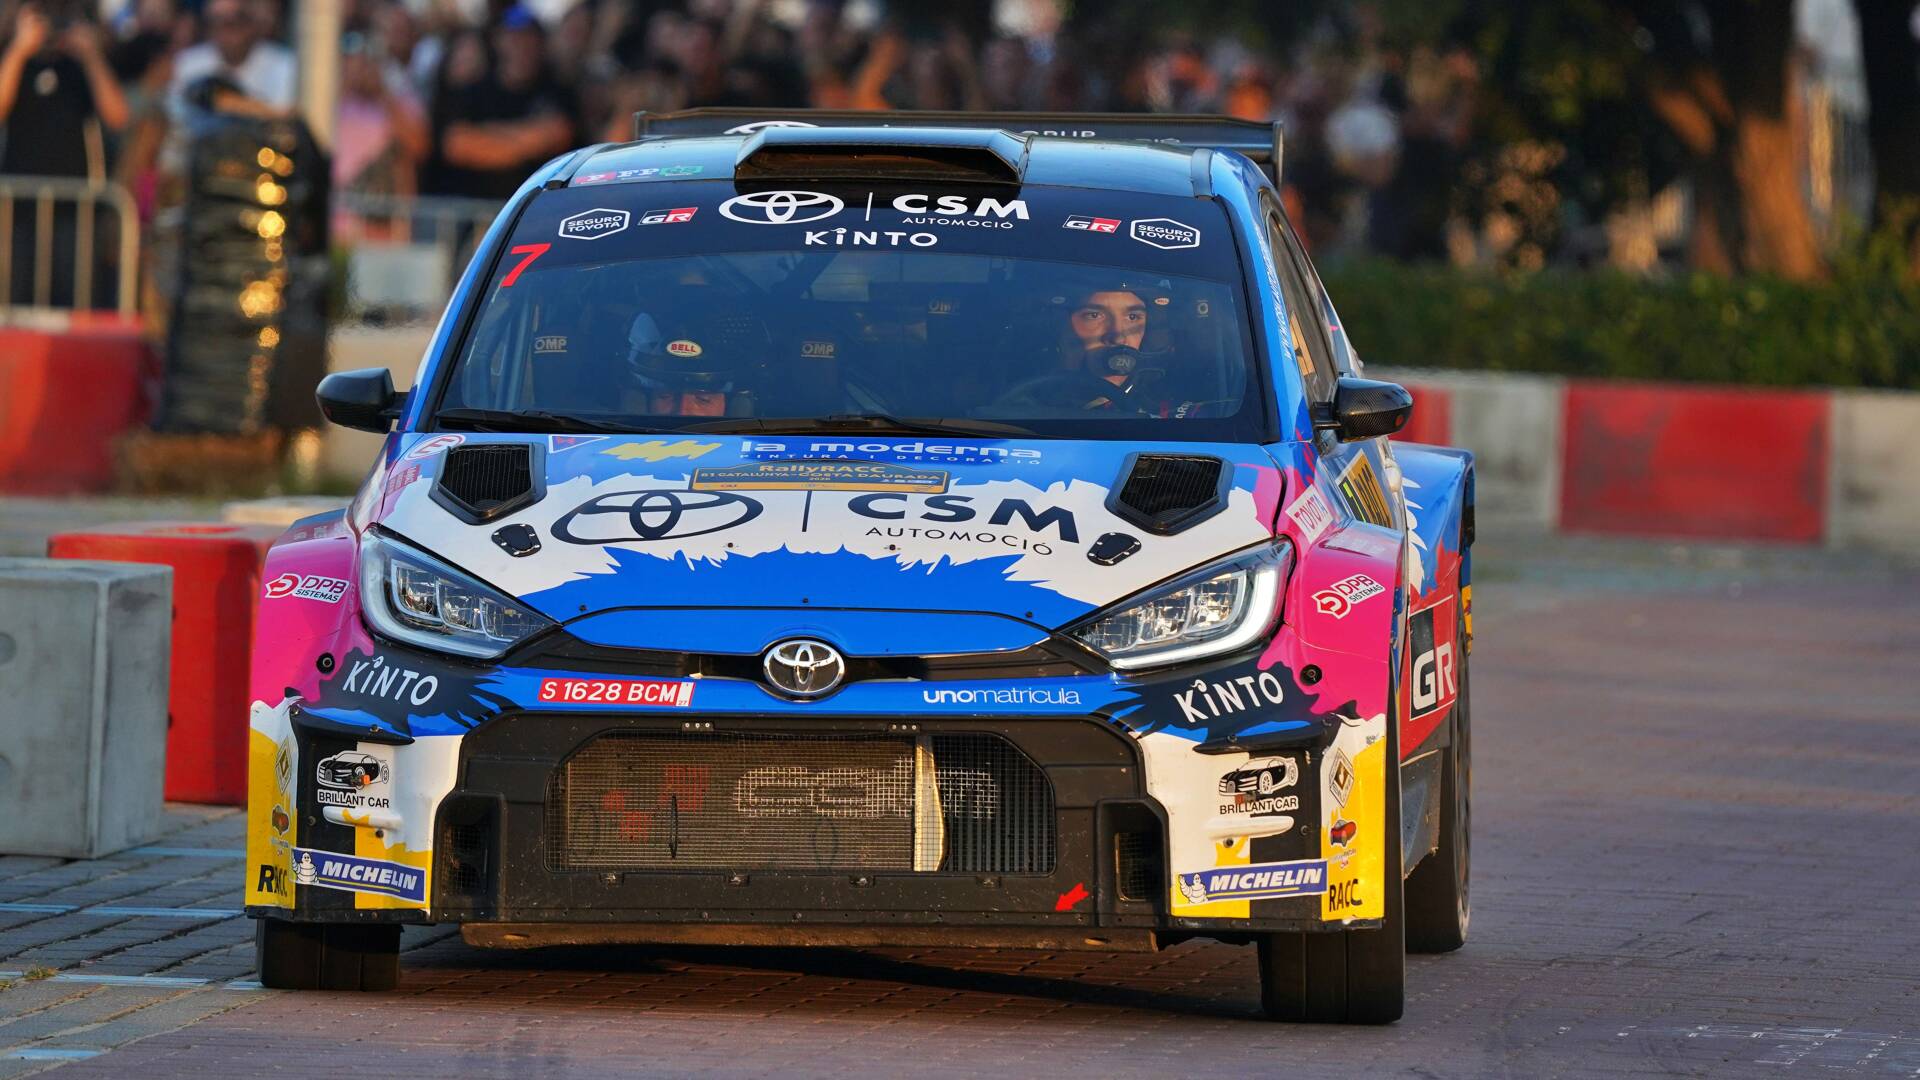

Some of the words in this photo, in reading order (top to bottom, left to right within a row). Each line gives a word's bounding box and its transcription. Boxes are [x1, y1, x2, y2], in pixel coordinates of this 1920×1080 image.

[893, 193, 1031, 220] CSM
[567, 215, 623, 228] SEGURO
[567, 221, 621, 233] TOYOTA
[642, 212, 692, 224] GR
[902, 216, 1014, 229] AUTOMOCIÓ
[1065, 217, 1118, 233] GR
[804, 227, 938, 248] KINTO
[1138, 224, 1194, 237] SEGURO
[1138, 230, 1193, 243] TOYOTA
[499, 243, 551, 288] 7
[534, 337, 567, 351] OMP
[670, 343, 697, 353] BELL
[802, 343, 835, 355] OMP
[740, 441, 786, 452] la
[811, 441, 1042, 458] moderna
[896, 455, 1041, 465] DECORACIÓ
[759, 465, 886, 475] RallyRACC
[847, 493, 1080, 545] CSM
[865, 526, 1053, 557] AUTOMOCIÓ
[301, 576, 348, 594] DPB
[1336, 574, 1374, 597] DPB
[1348, 583, 1384, 603] SISTEMAS
[294, 588, 340, 602] SISTEMAS
[342, 655, 439, 706] KINTO
[1412, 641, 1455, 710] GR
[542, 681, 558, 700] S
[563, 681, 621, 701] 1628
[627, 683, 678, 703] BCM
[923, 688, 1081, 706] unomatricula
[1172, 672, 1284, 723] KINTO
[318, 790, 365, 806] BRILLANT
[368, 797, 390, 809] CAR
[1219, 799, 1274, 815] BRILLANT
[1275, 798, 1297, 810] CAR
[321, 860, 418, 892] MICHELIN
[1209, 868, 1323, 892] MICHELIN
[1329, 878, 1363, 912] RACC
